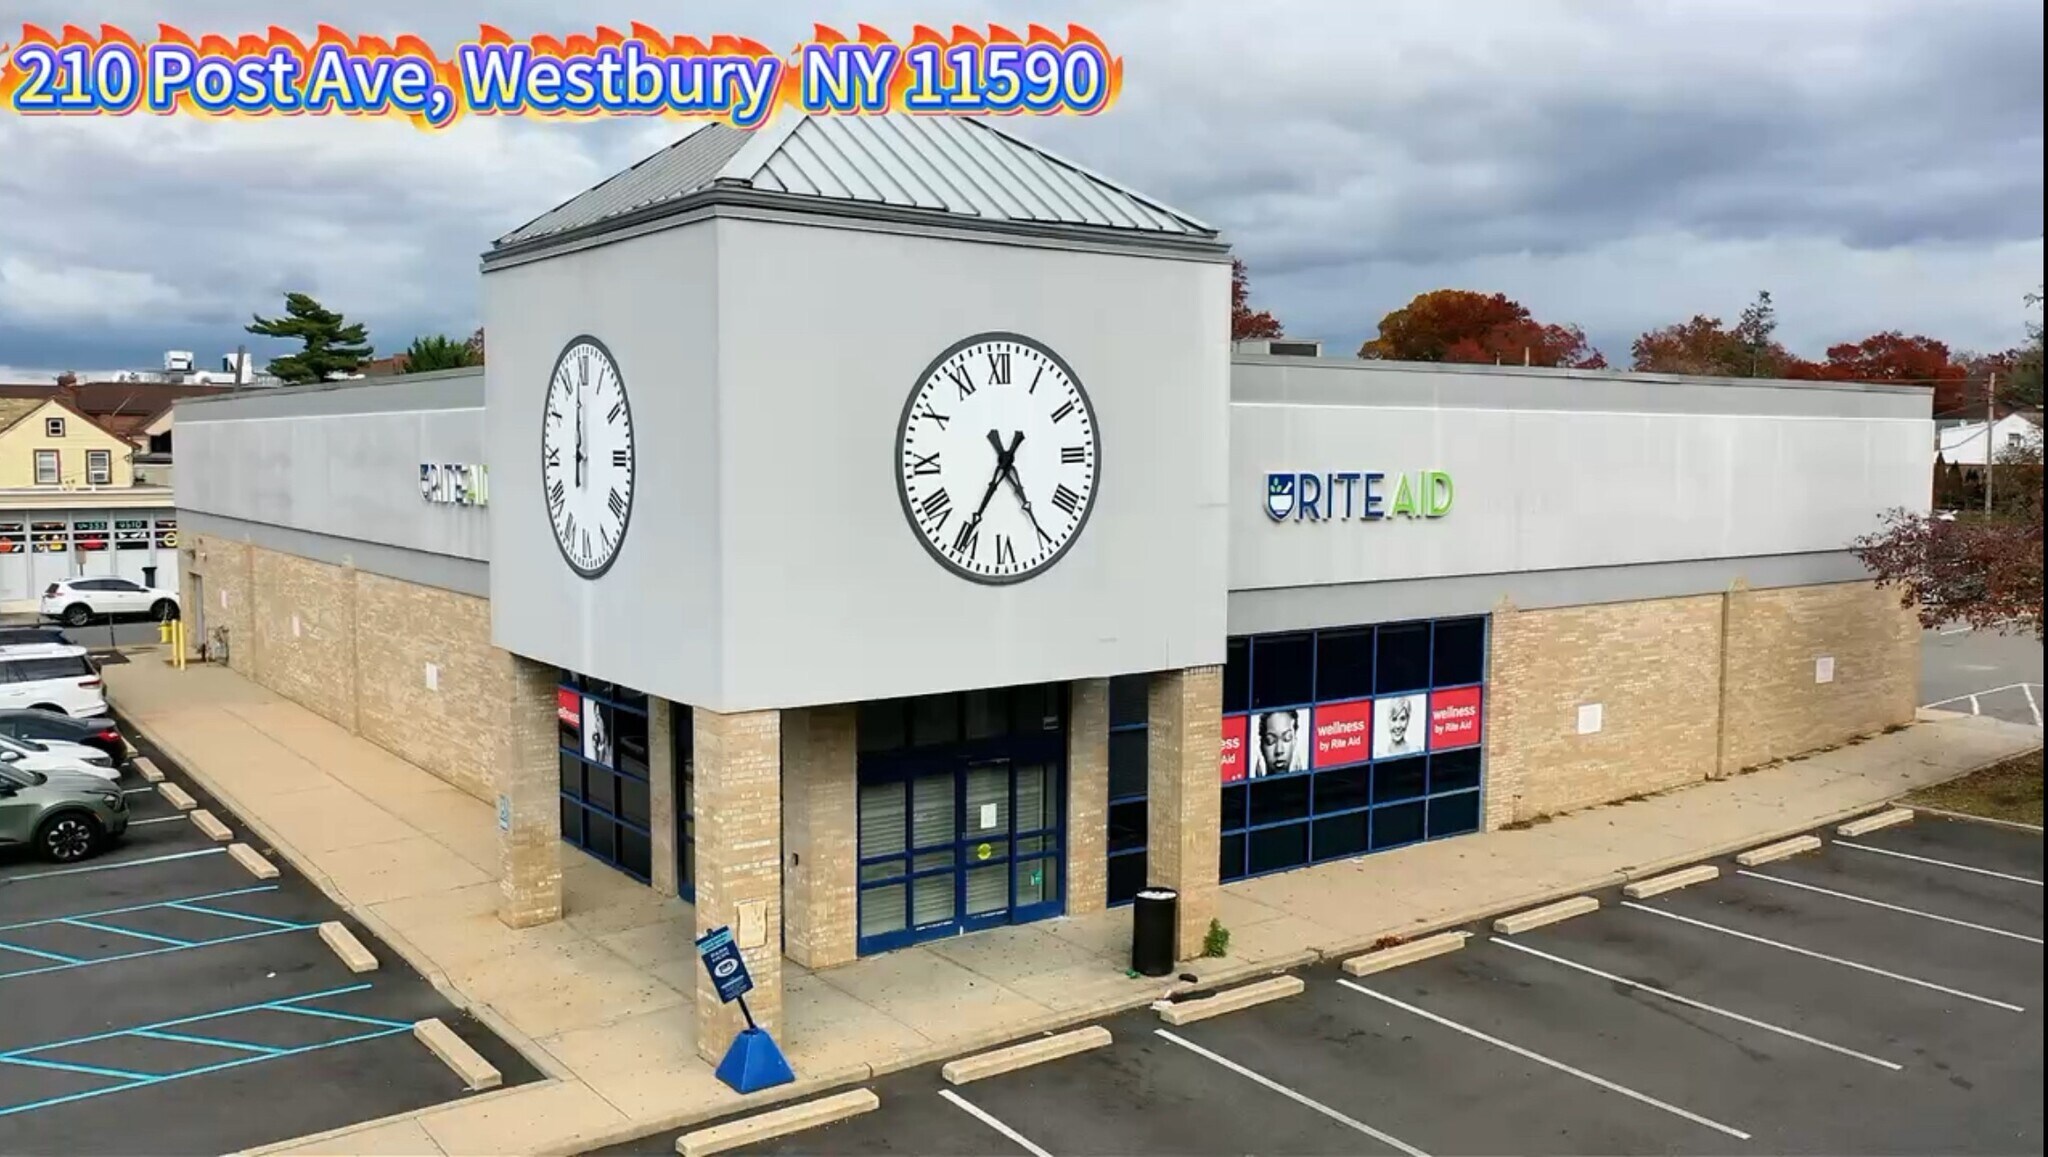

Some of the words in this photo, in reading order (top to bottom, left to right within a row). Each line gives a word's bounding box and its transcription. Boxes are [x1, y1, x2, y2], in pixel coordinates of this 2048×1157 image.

[988, 353, 1011, 385] XII
[1299, 472, 1385, 520] RITE
[1391, 471, 1454, 518] AID
[1433, 705, 1476, 720] wellness
[1317, 720, 1365, 737] wellness
[1319, 740, 1330, 752] by
[1330, 738, 1347, 749] Rite
[1347, 735, 1361, 747] Aid
